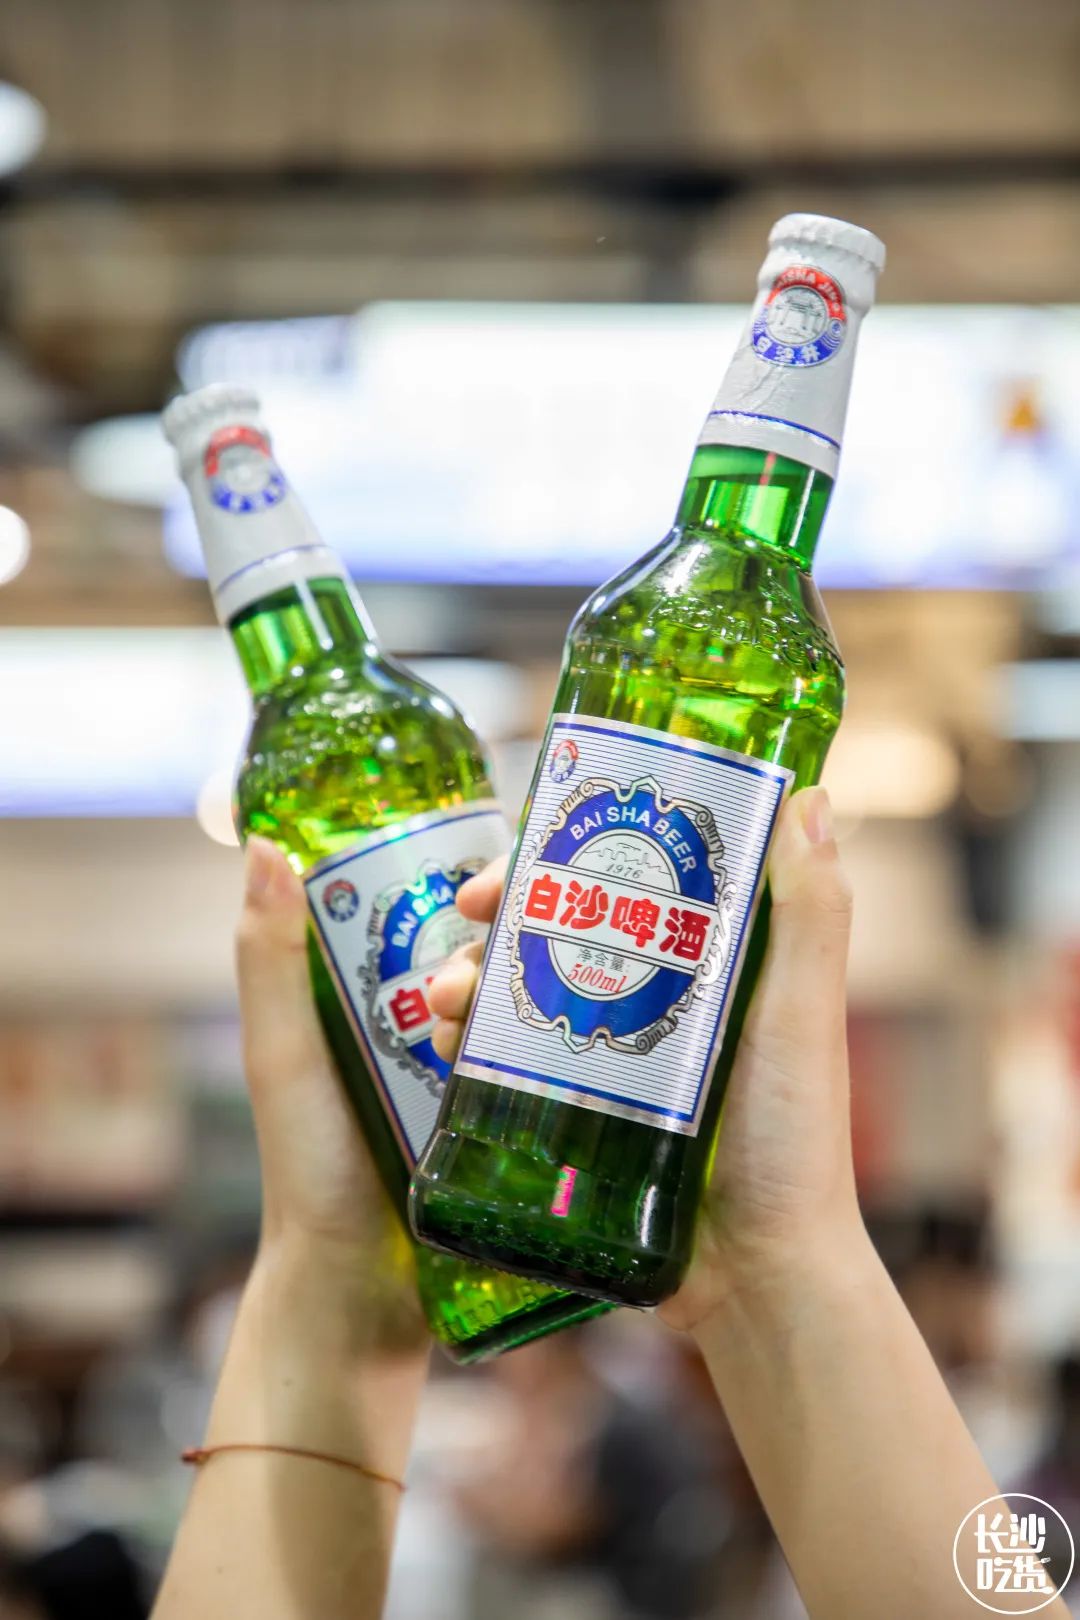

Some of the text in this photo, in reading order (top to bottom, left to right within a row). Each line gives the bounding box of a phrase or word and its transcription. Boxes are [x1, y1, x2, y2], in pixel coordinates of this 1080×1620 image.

[570, 801, 697, 873] BAI SHA BEER
[605, 863, 644, 879] 1976
[524, 874, 711, 961] 白沙啤酒
[567, 963, 628, 993] 500ml
